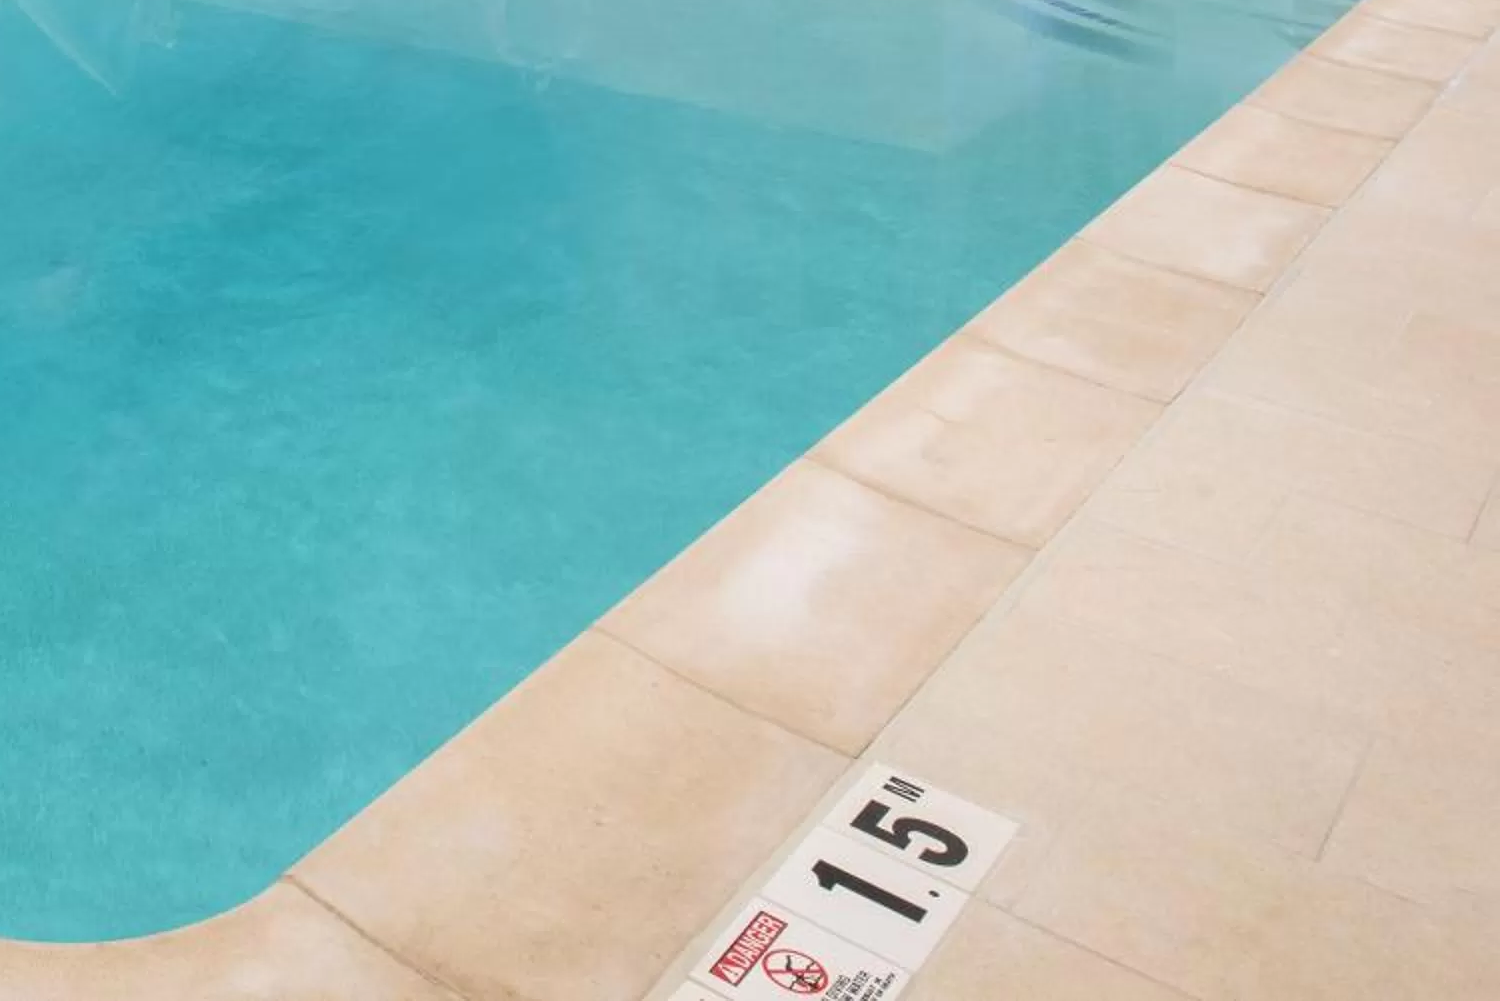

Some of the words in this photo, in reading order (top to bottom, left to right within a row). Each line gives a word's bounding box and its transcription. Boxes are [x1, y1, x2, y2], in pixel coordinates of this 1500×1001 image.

[883, 776, 924, 802] M
[811, 799, 969, 924] 1.5
[730, 914, 785, 971] DANGER
